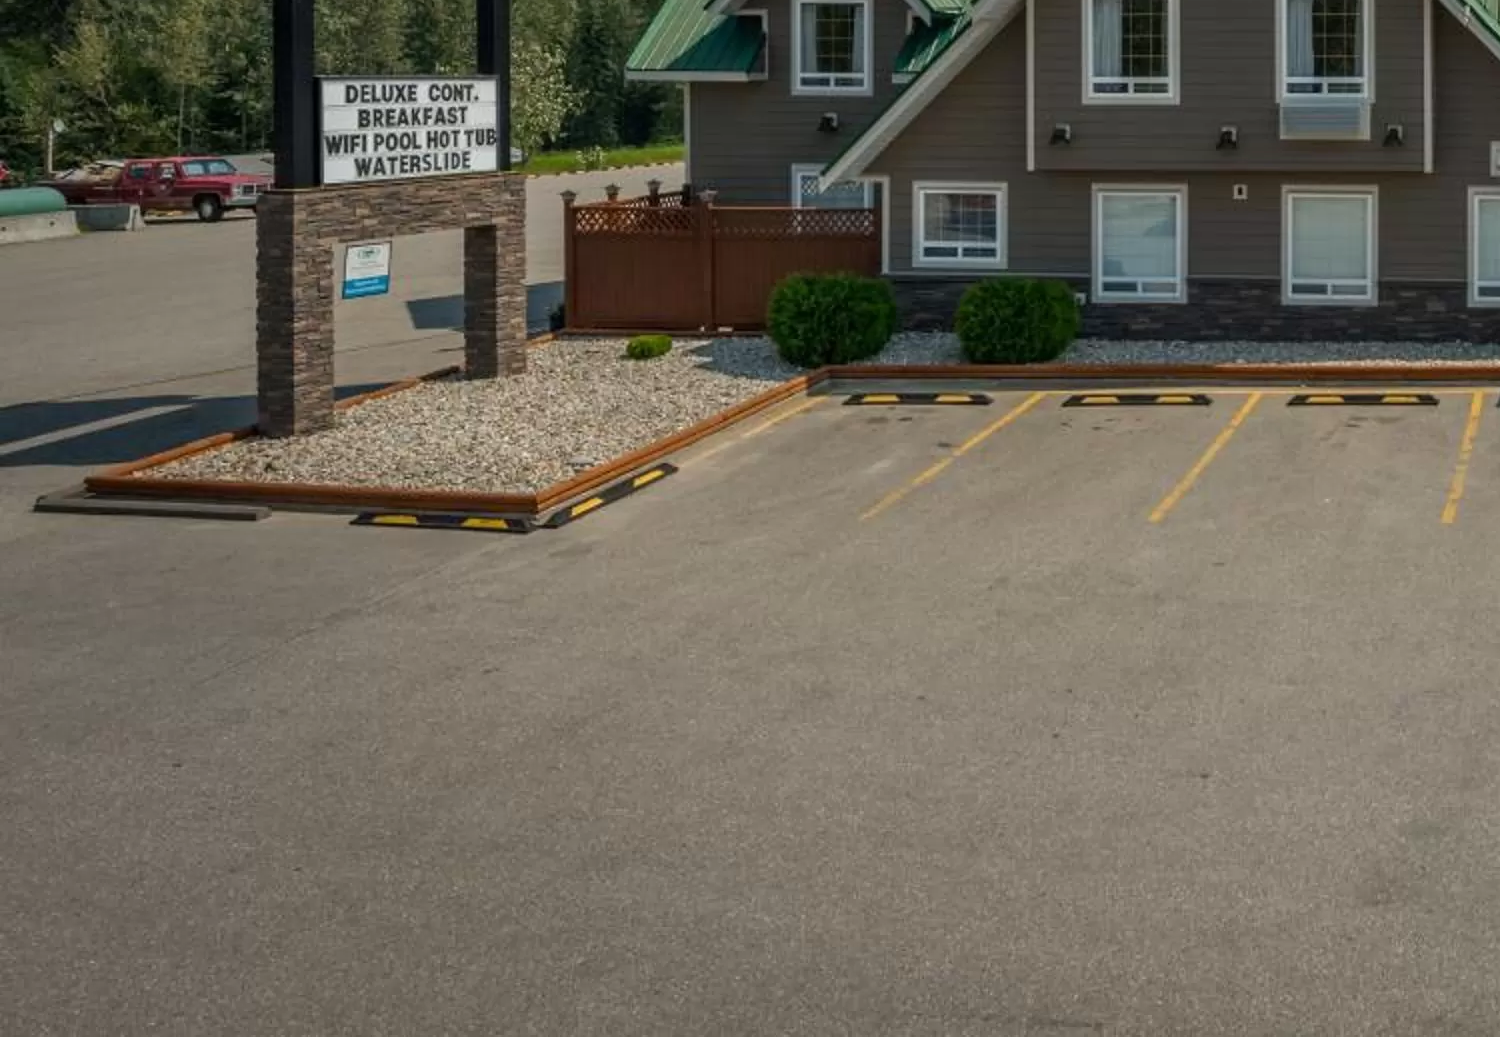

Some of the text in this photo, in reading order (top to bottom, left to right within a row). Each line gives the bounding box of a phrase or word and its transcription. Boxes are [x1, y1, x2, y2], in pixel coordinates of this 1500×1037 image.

[345, 83, 479, 104] DELUXE CONT.
[357, 106, 468, 128] BREAKFAST
[325, 128, 497, 155] WIFI POOL HOT TUB
[354, 151, 471, 177] WATERSLIDE
